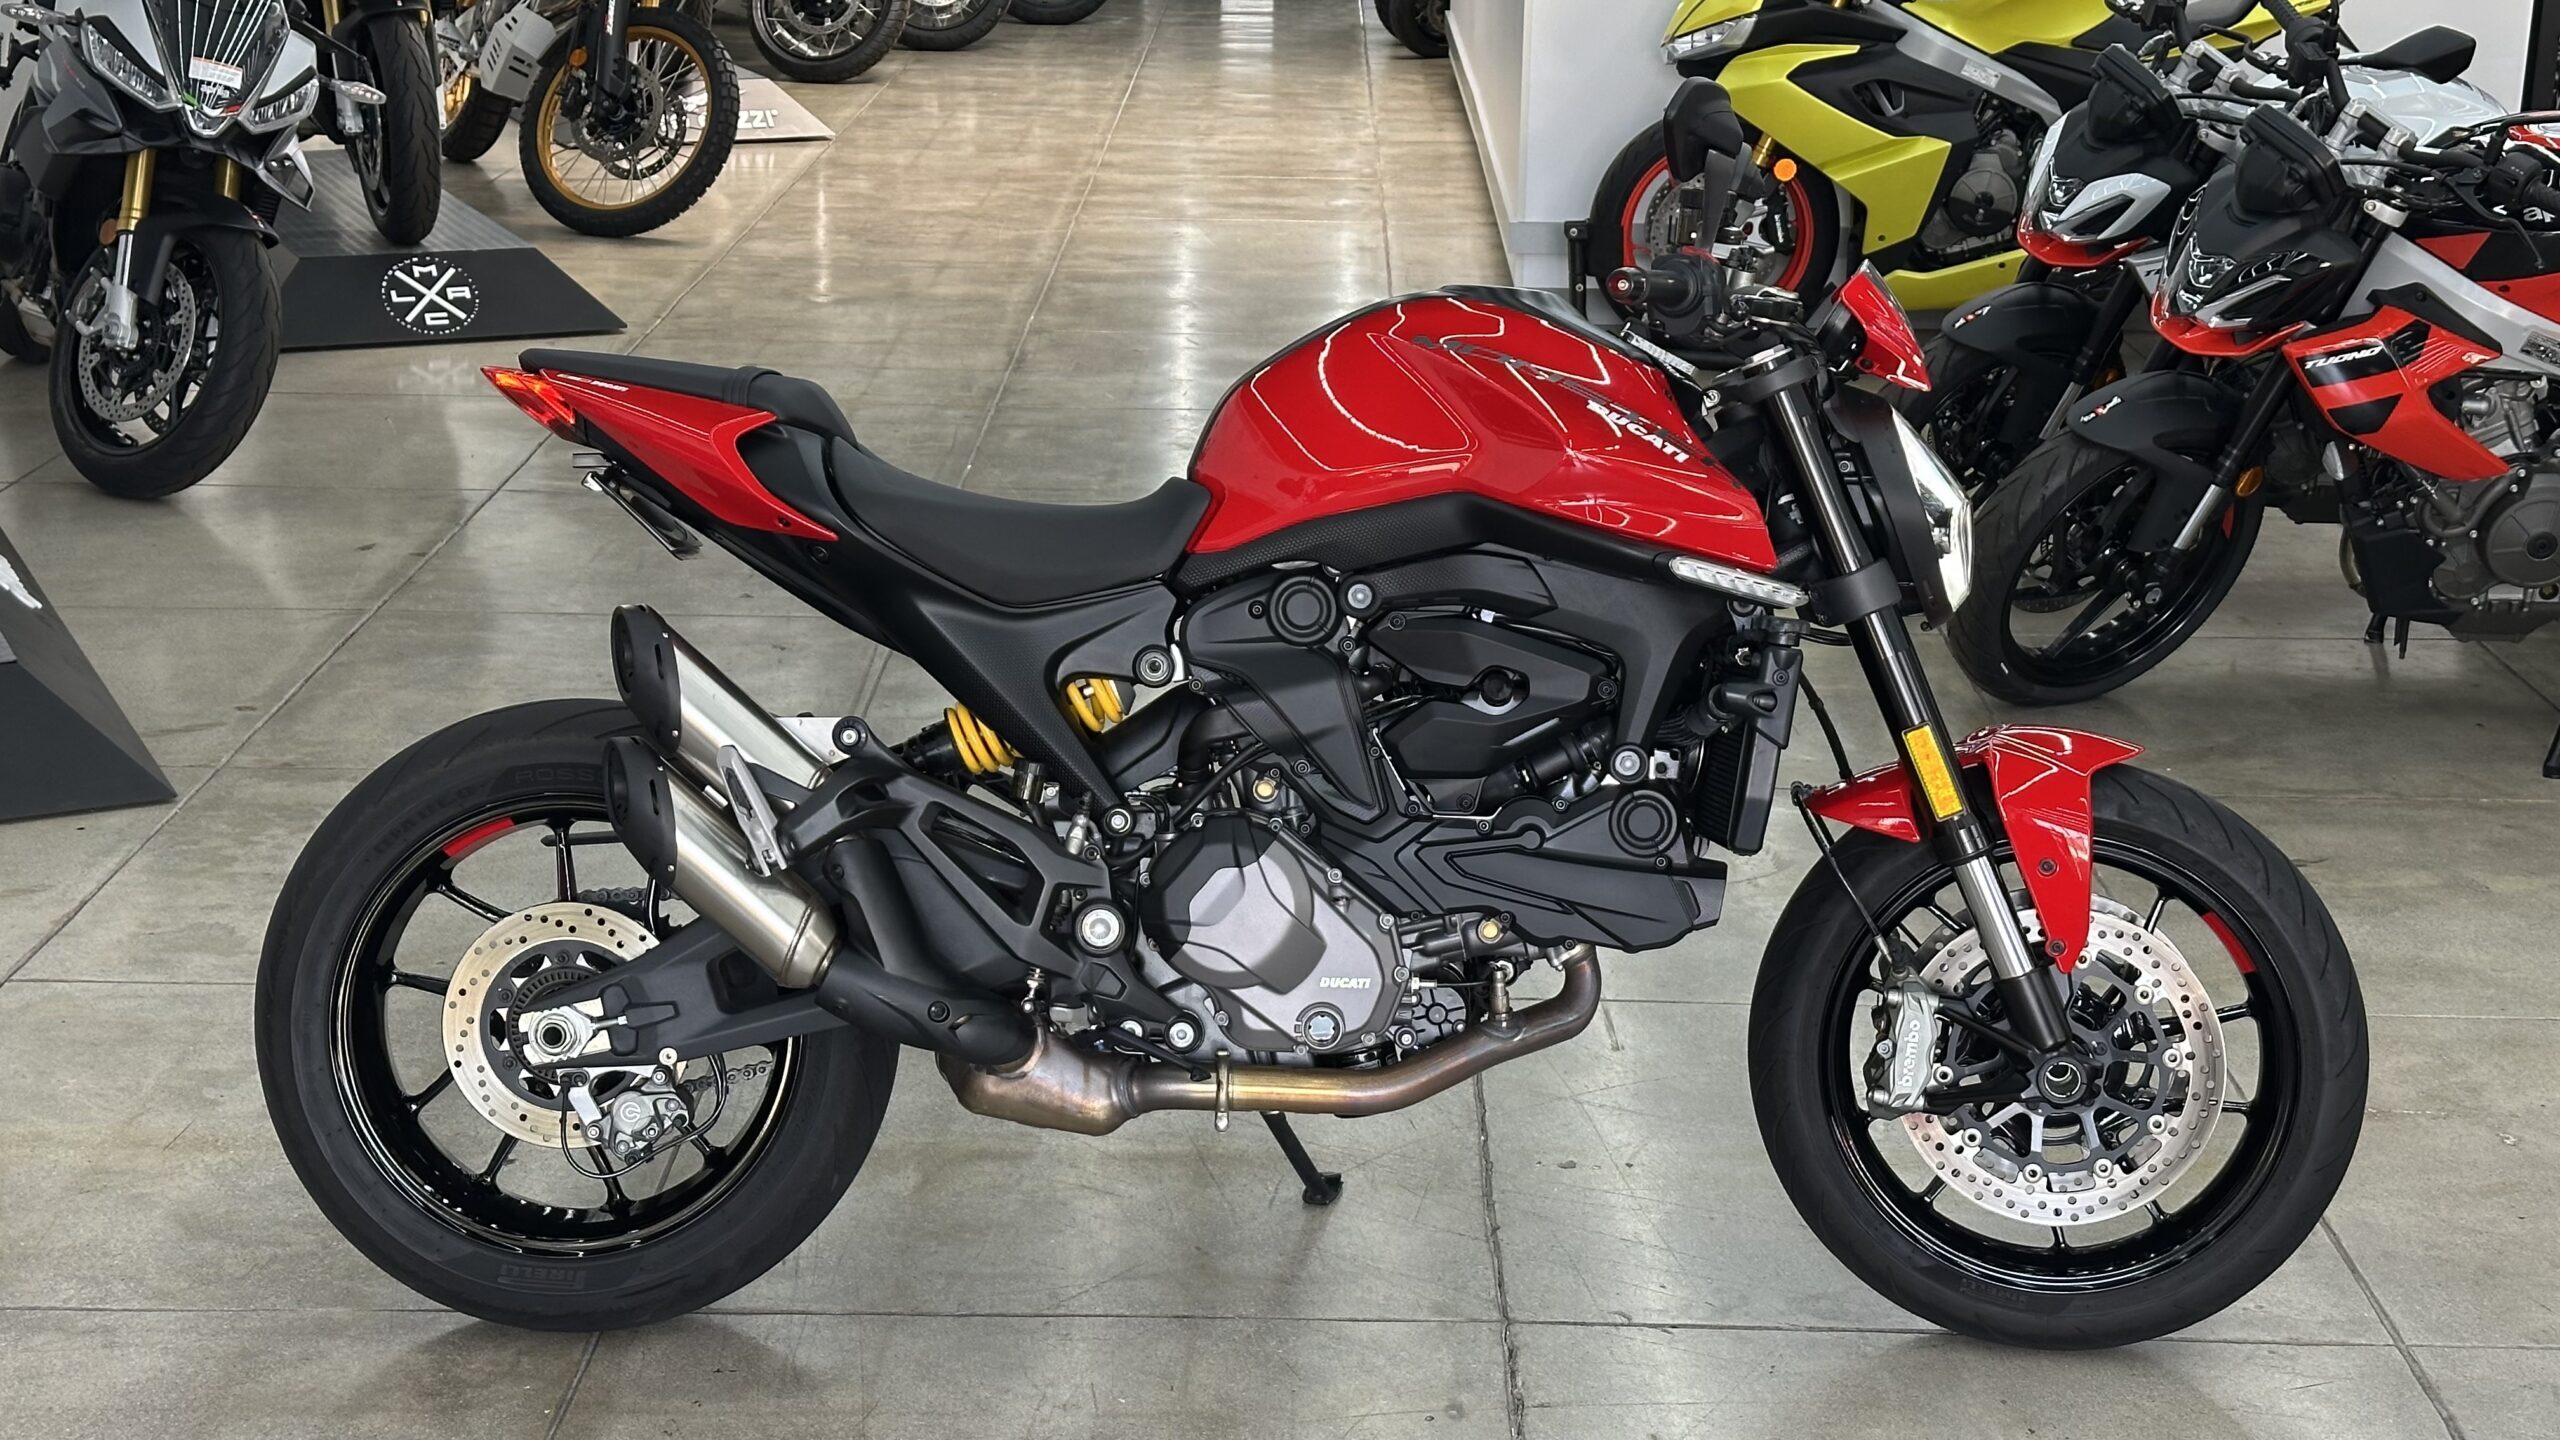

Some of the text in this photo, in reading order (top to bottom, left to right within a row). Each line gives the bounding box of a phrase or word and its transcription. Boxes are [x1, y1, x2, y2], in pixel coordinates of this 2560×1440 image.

[2304, 346, 2384, 369] TUONO
[1586, 399, 1690, 463] DUCATI
[1320, 976, 1371, 989] DUCATI
[1897, 1019, 1921, 1087] brembo
